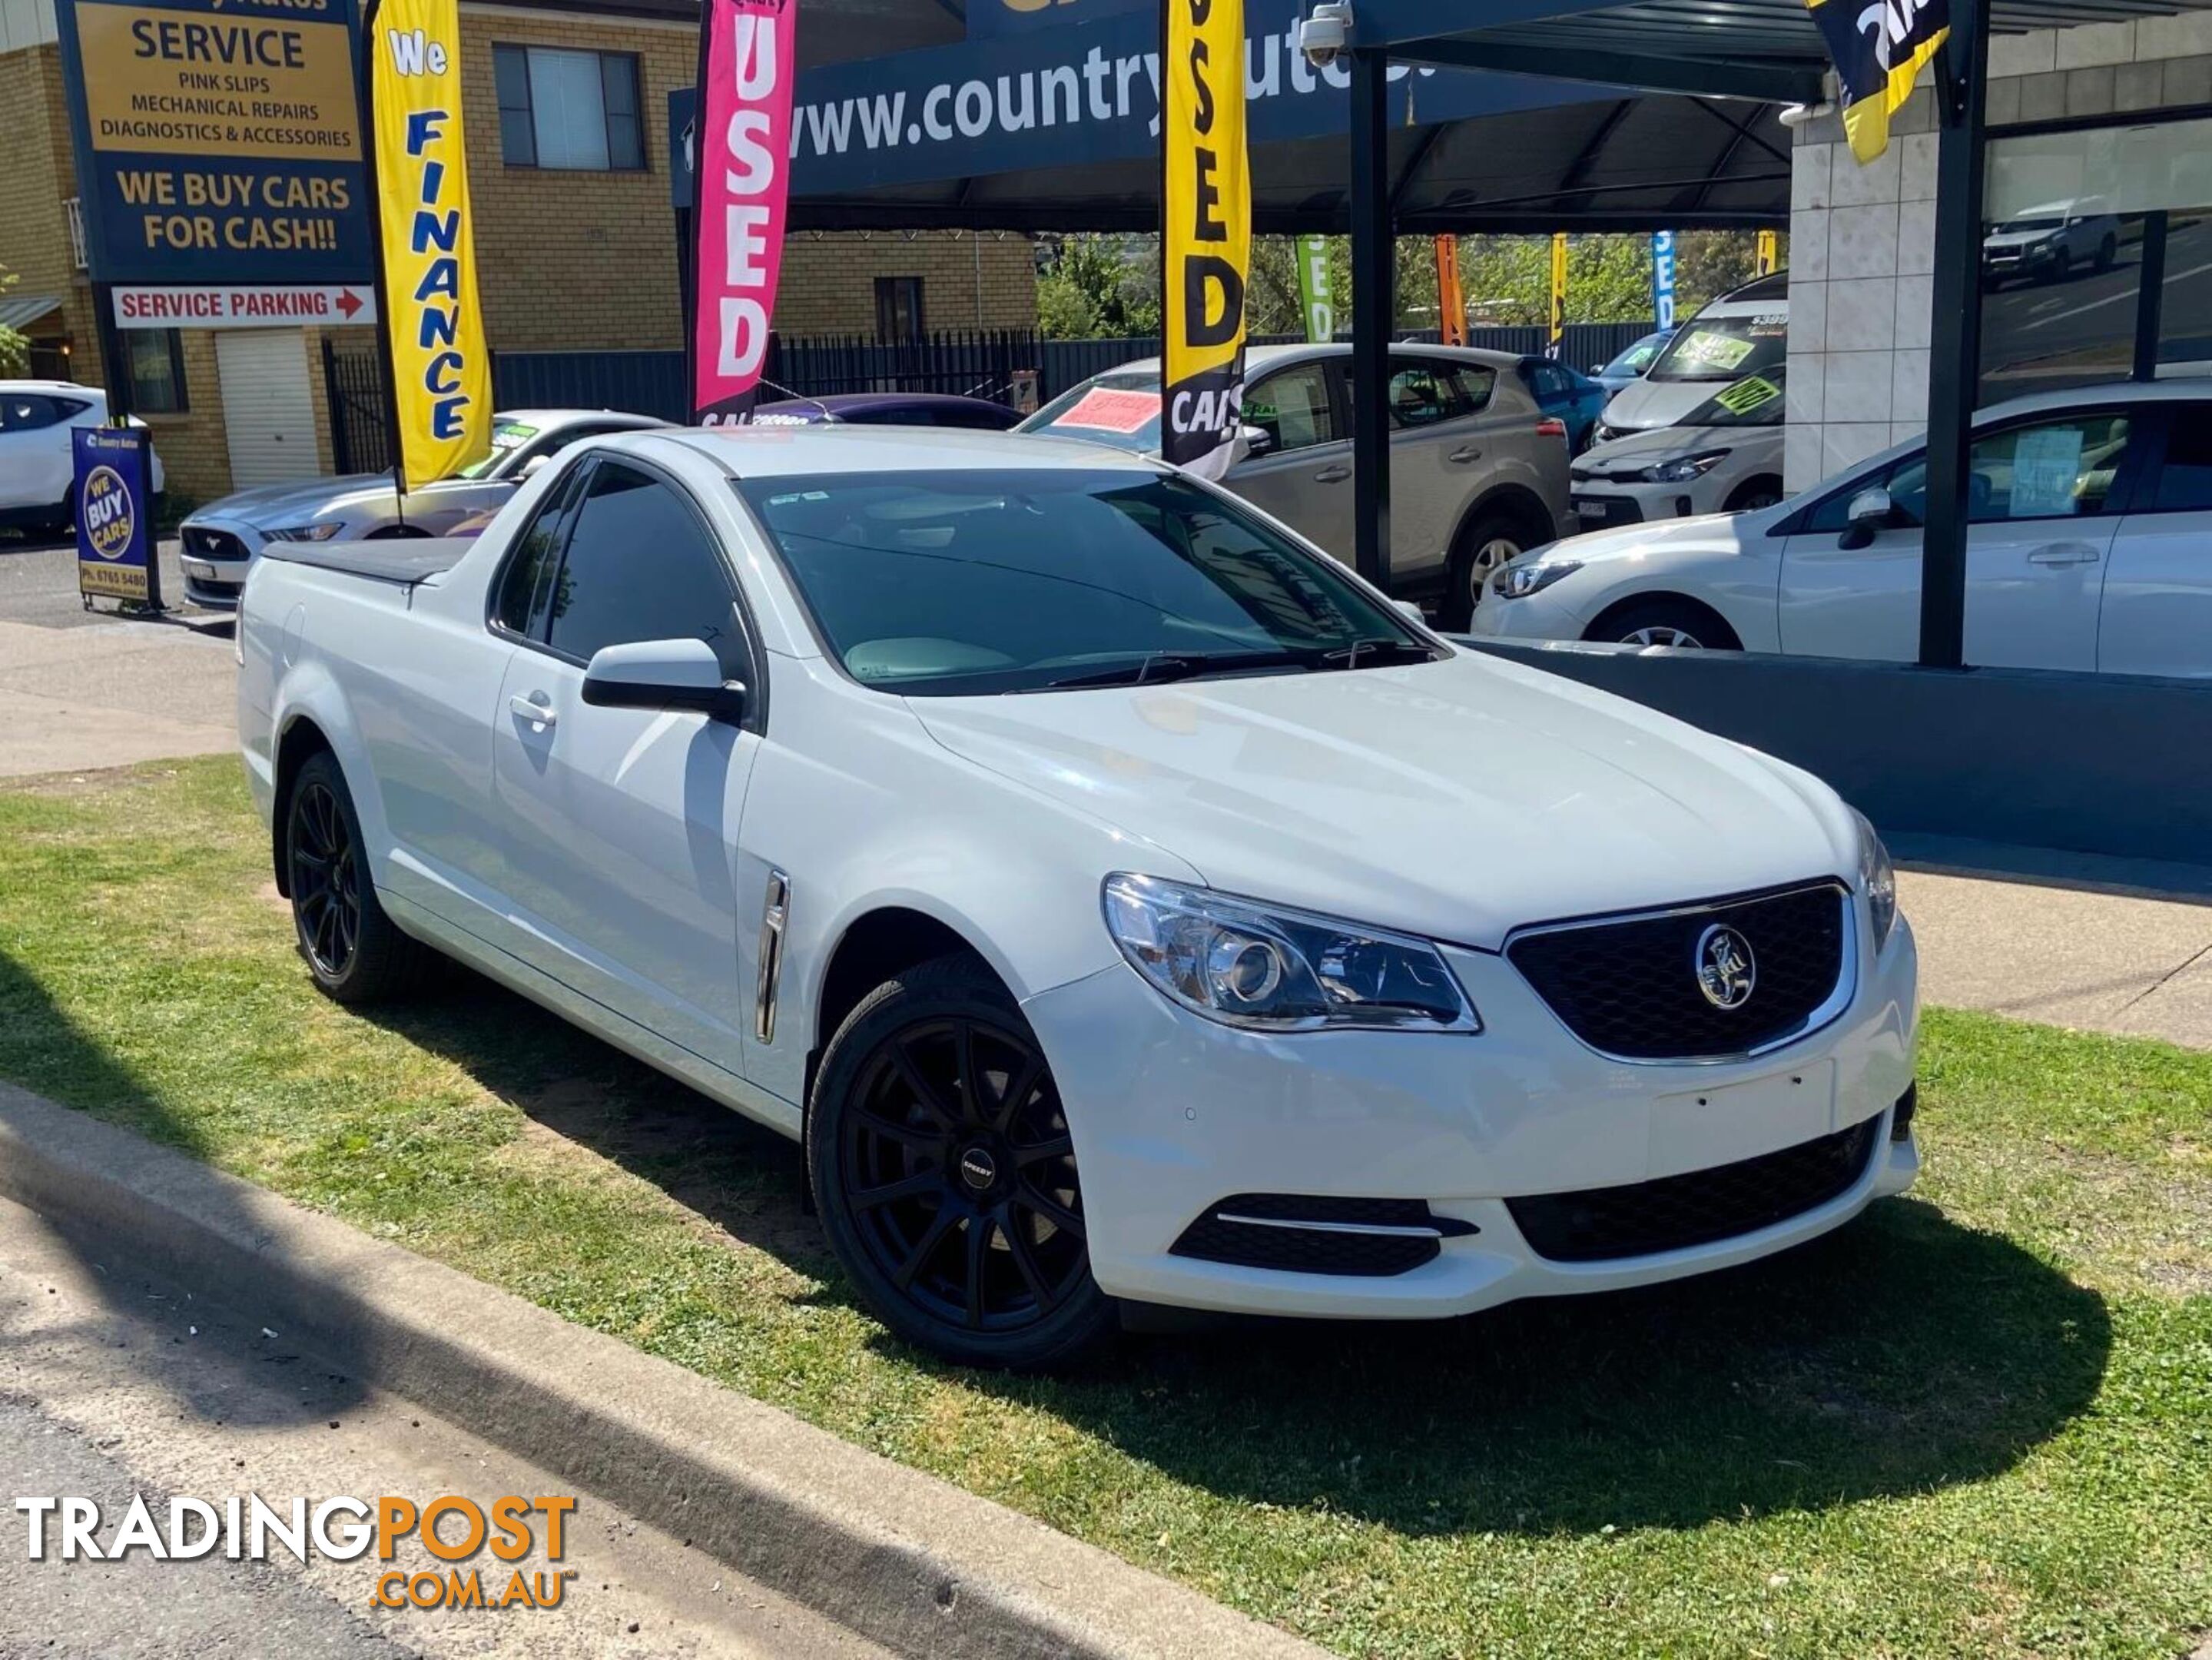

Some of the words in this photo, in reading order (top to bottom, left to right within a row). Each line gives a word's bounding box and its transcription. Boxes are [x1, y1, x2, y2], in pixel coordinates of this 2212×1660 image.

[131, 19, 305, 68] SERVICE
[389, 28, 449, 77] We
[179, 72, 221, 91] PINK
[224, 75, 270, 94] SLIPS
[132, 95, 249, 117] MECHANICAL
[252, 101, 319, 121] REPAIRS
[101, 120, 222, 141] DIAGNOSTICS
[226, 126, 238, 142] &
[243, 127, 351, 148] ACCESSORIES
[117, 171, 177, 206] WE
[184, 173, 254, 208] BUY
[263, 176, 350, 210] CARS
[721, 14, 776, 377] USED
[144, 215, 217, 250] FOR
[225, 217, 337, 251] CASH!!
[406, 110, 470, 440] FINANCE
[121, 293, 223, 317] SERVICE
[231, 291, 327, 317] PARKING
[90, 476, 111, 498] WE
[87, 489, 124, 530] BUY
[93, 517, 129, 549] CARS
